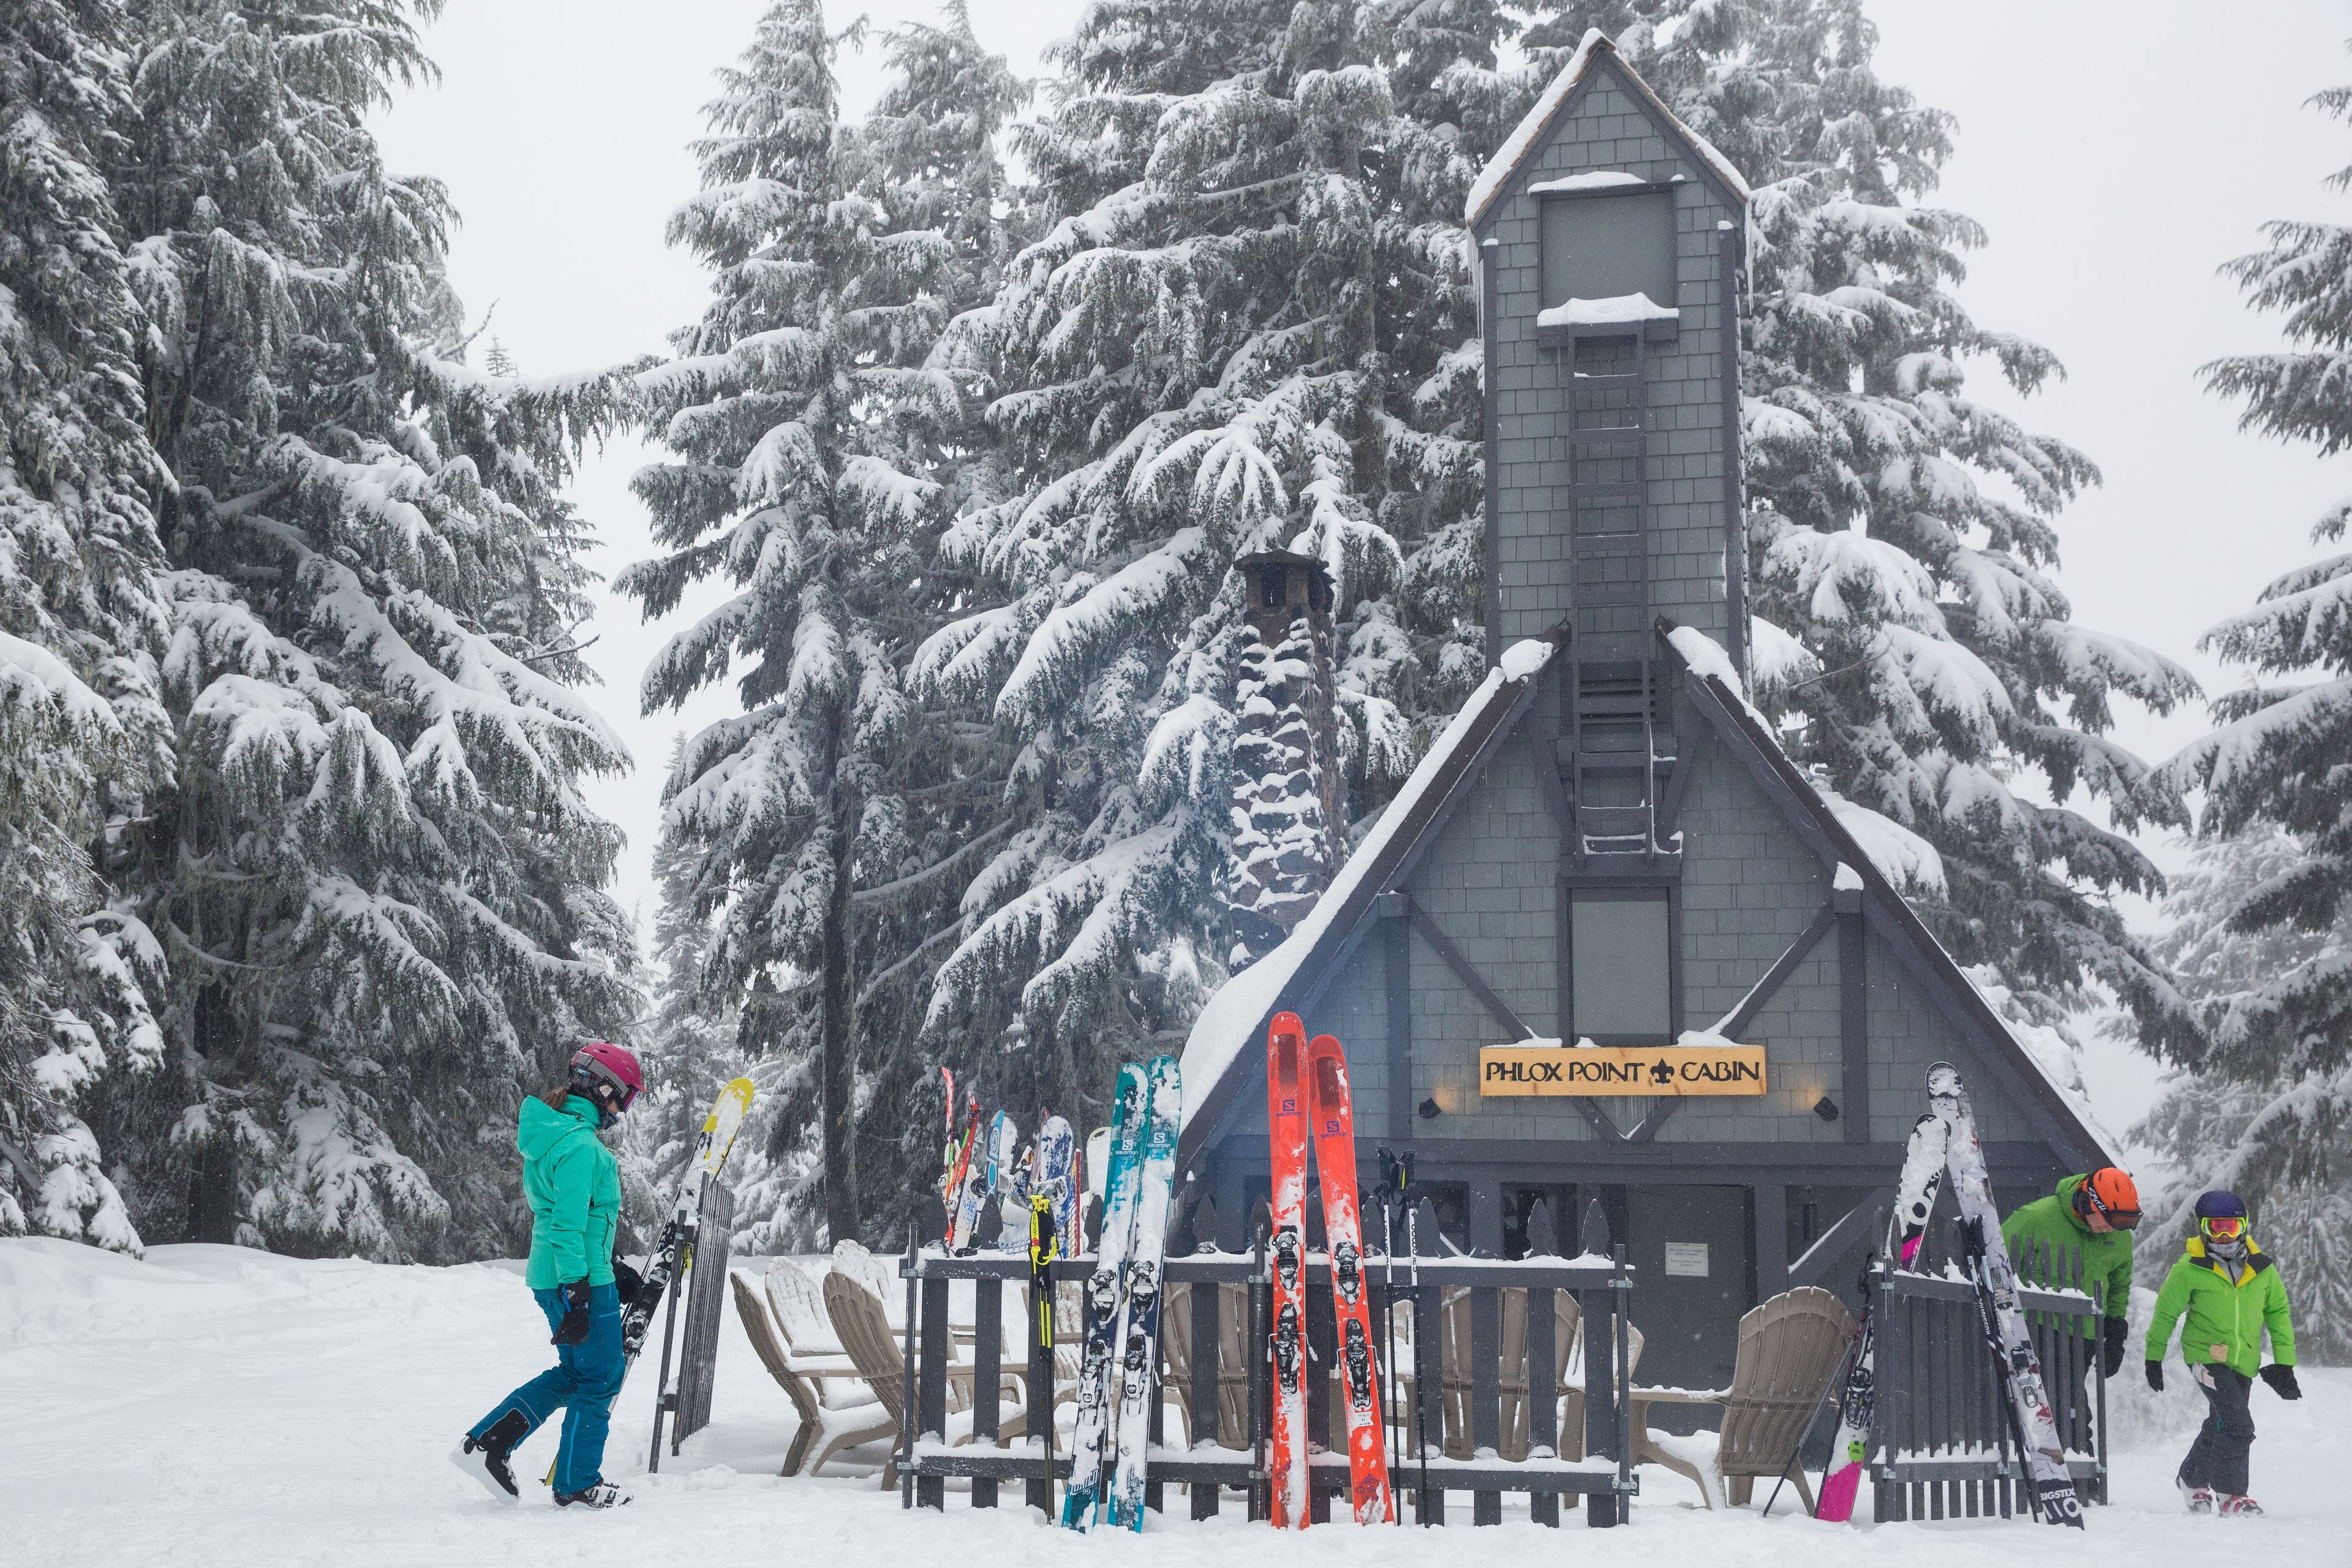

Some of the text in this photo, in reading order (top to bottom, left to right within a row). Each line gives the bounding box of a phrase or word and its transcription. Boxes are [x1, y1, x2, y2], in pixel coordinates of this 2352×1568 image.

[1485, 1061, 1761, 1082] PHLOX POINT CABIN
[2087, 1187, 2107, 1212] SMITH
[2040, 1488, 2076, 1501] BIGSTIX
[2041, 1497, 2081, 1520] 110
